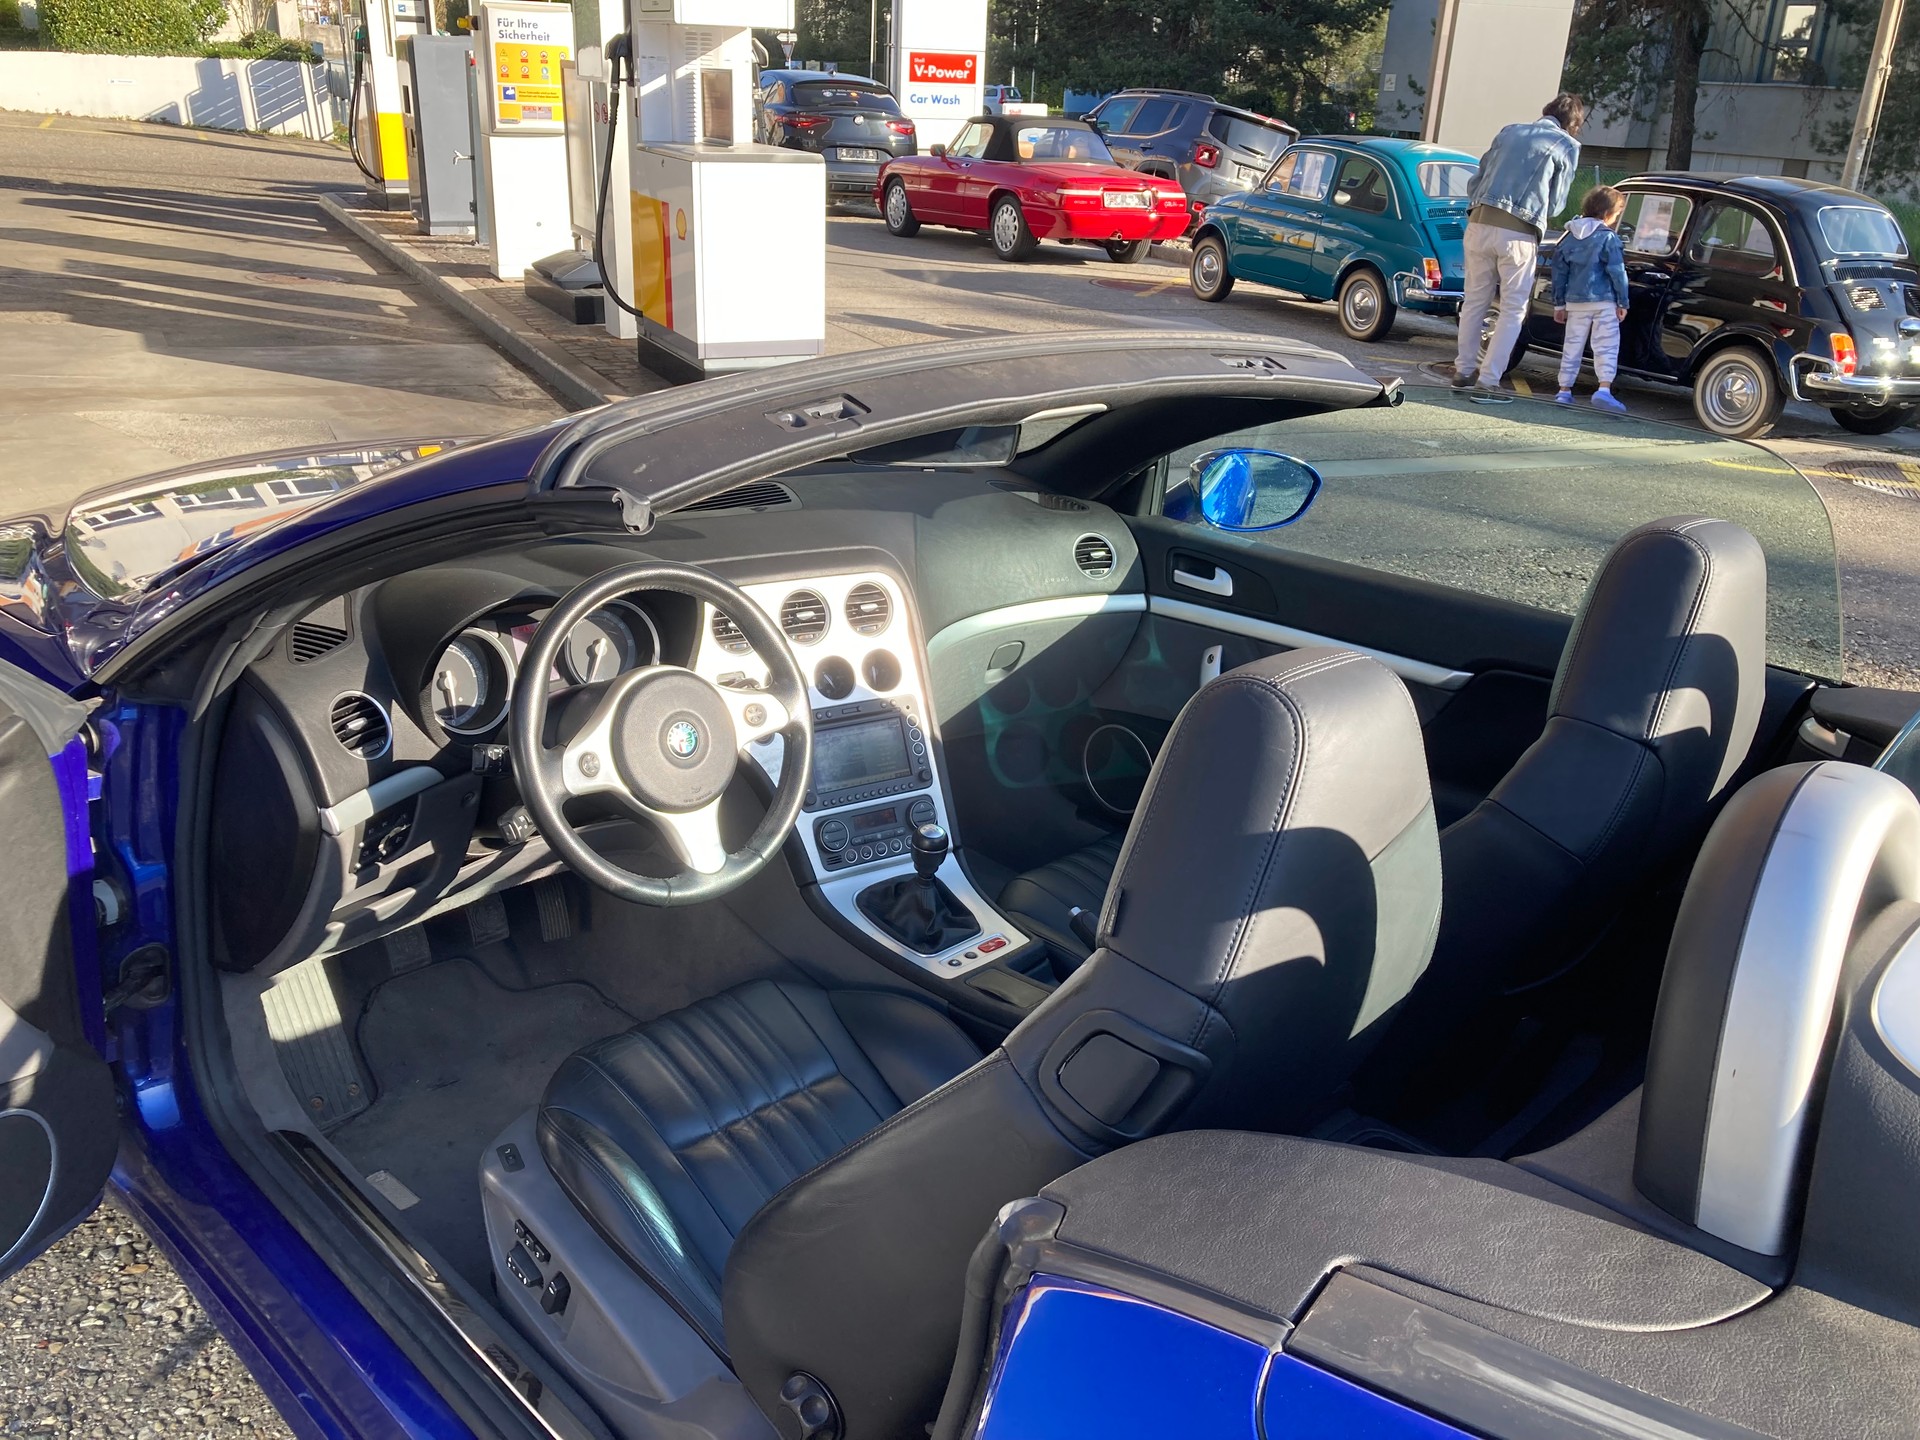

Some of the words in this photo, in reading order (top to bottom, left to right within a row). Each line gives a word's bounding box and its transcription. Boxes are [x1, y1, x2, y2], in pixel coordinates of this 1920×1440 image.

[497, 17, 514, 28] Für
[517, 18, 539, 29] Ihre
[498, 29, 550, 42] Sicherheit
[914, 64, 970, 79] V-Power
[910, 93, 928, 104] Car
[931, 94, 960, 105] Wash
